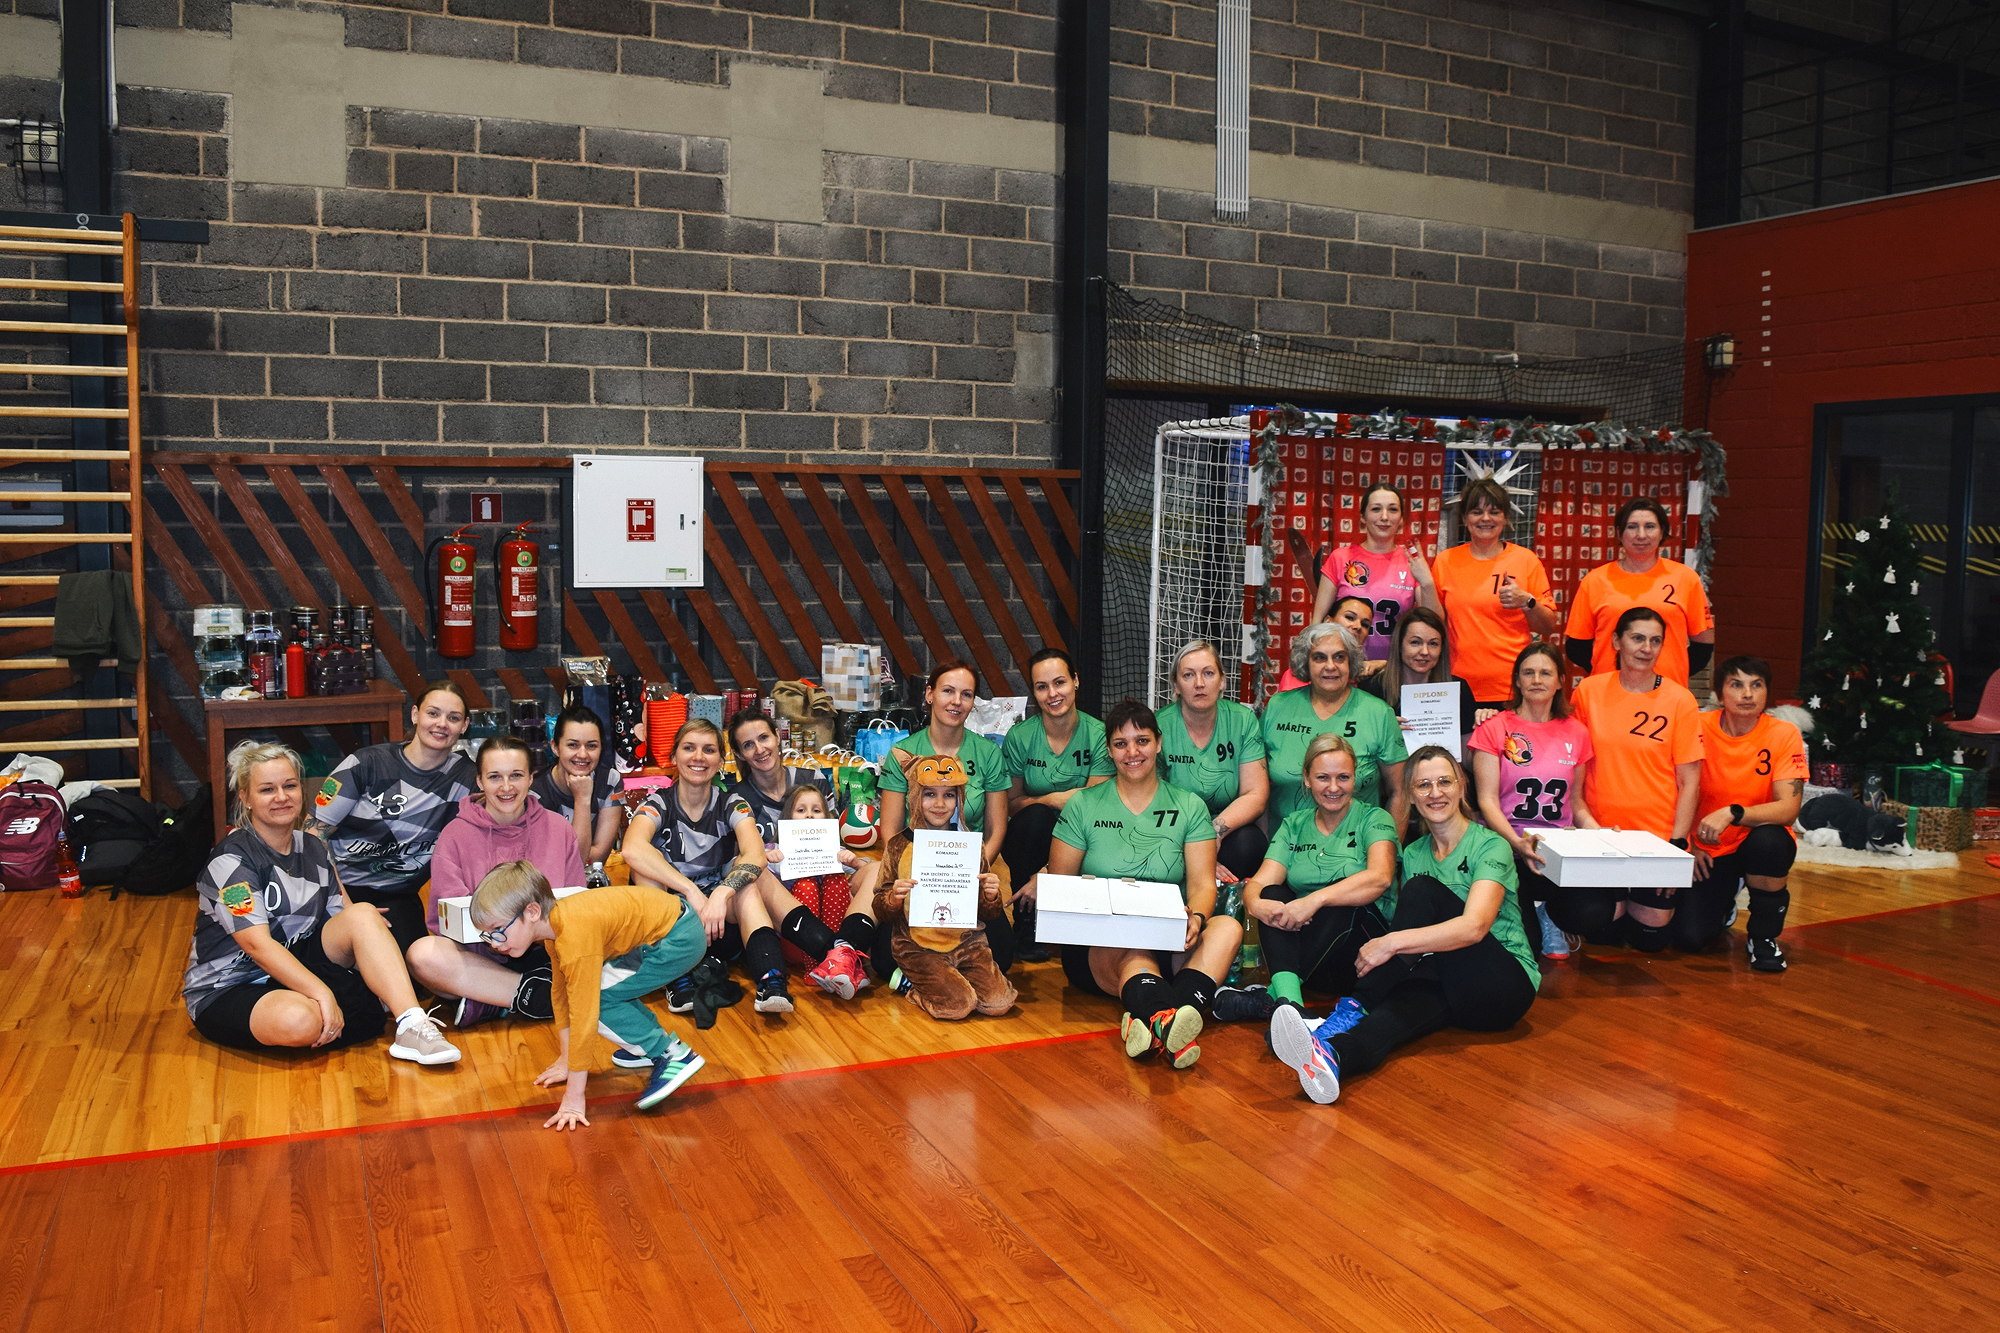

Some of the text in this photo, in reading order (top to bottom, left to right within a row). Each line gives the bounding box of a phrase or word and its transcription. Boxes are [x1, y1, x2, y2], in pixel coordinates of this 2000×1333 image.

[1661, 584, 1676, 605] 2
[1343, 721, 1357, 737] 5
[1629, 711, 1668, 742] 22
[1072, 749, 1093, 767] 15
[1216, 740, 1235, 762] 99
[966, 760, 976, 776] 3
[1755, 749, 1772, 775] 3
[1511, 777, 1568, 822] 33
[1093, 809, 1179, 829] ANNA 77
[660, 827, 686, 855] 21
[927, 840, 968, 849] DIPLOMS
[1457, 855, 1469, 873] 4
